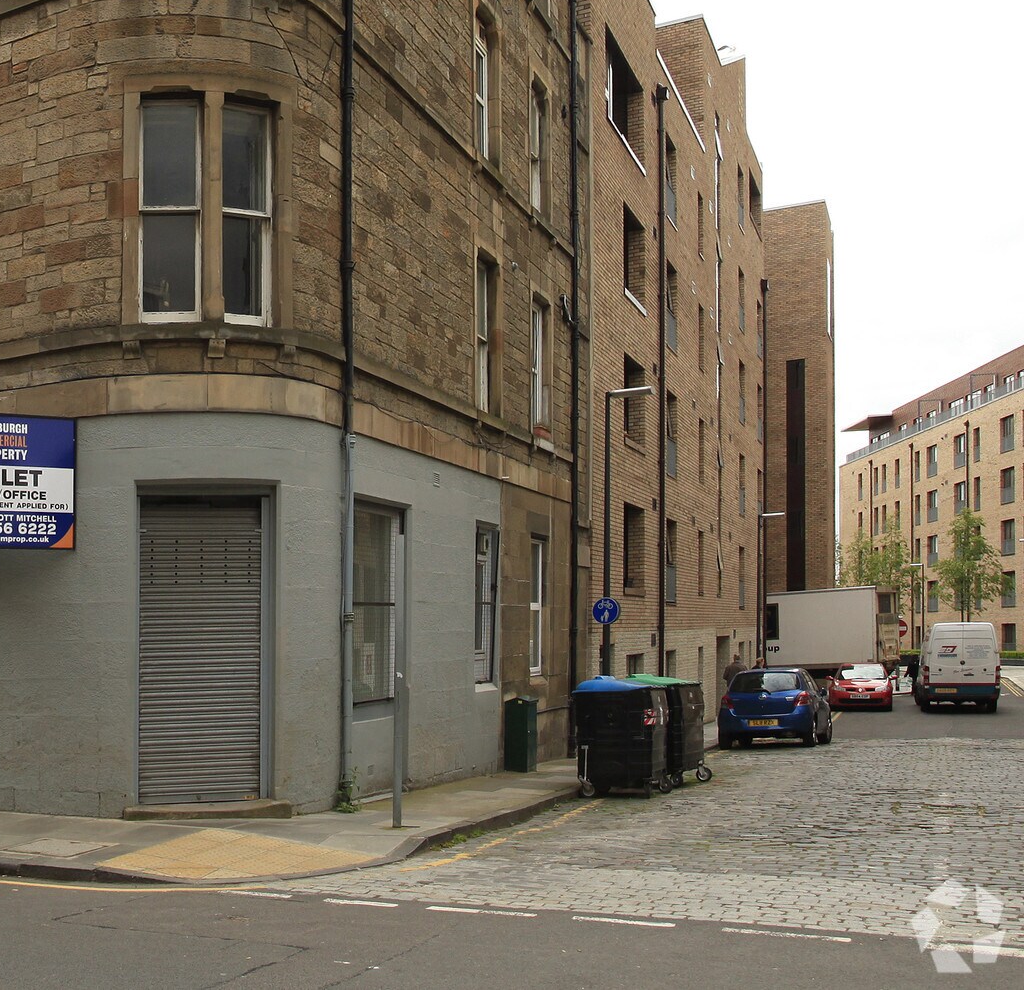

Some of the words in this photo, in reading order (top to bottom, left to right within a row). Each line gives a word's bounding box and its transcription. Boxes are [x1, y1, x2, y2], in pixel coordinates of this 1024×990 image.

[1, 468, 42, 487] LET
[16, 502, 47, 510] APPLIED
[16, 514, 57, 522] MITCHELL
[18, 523, 56, 535] 6222
